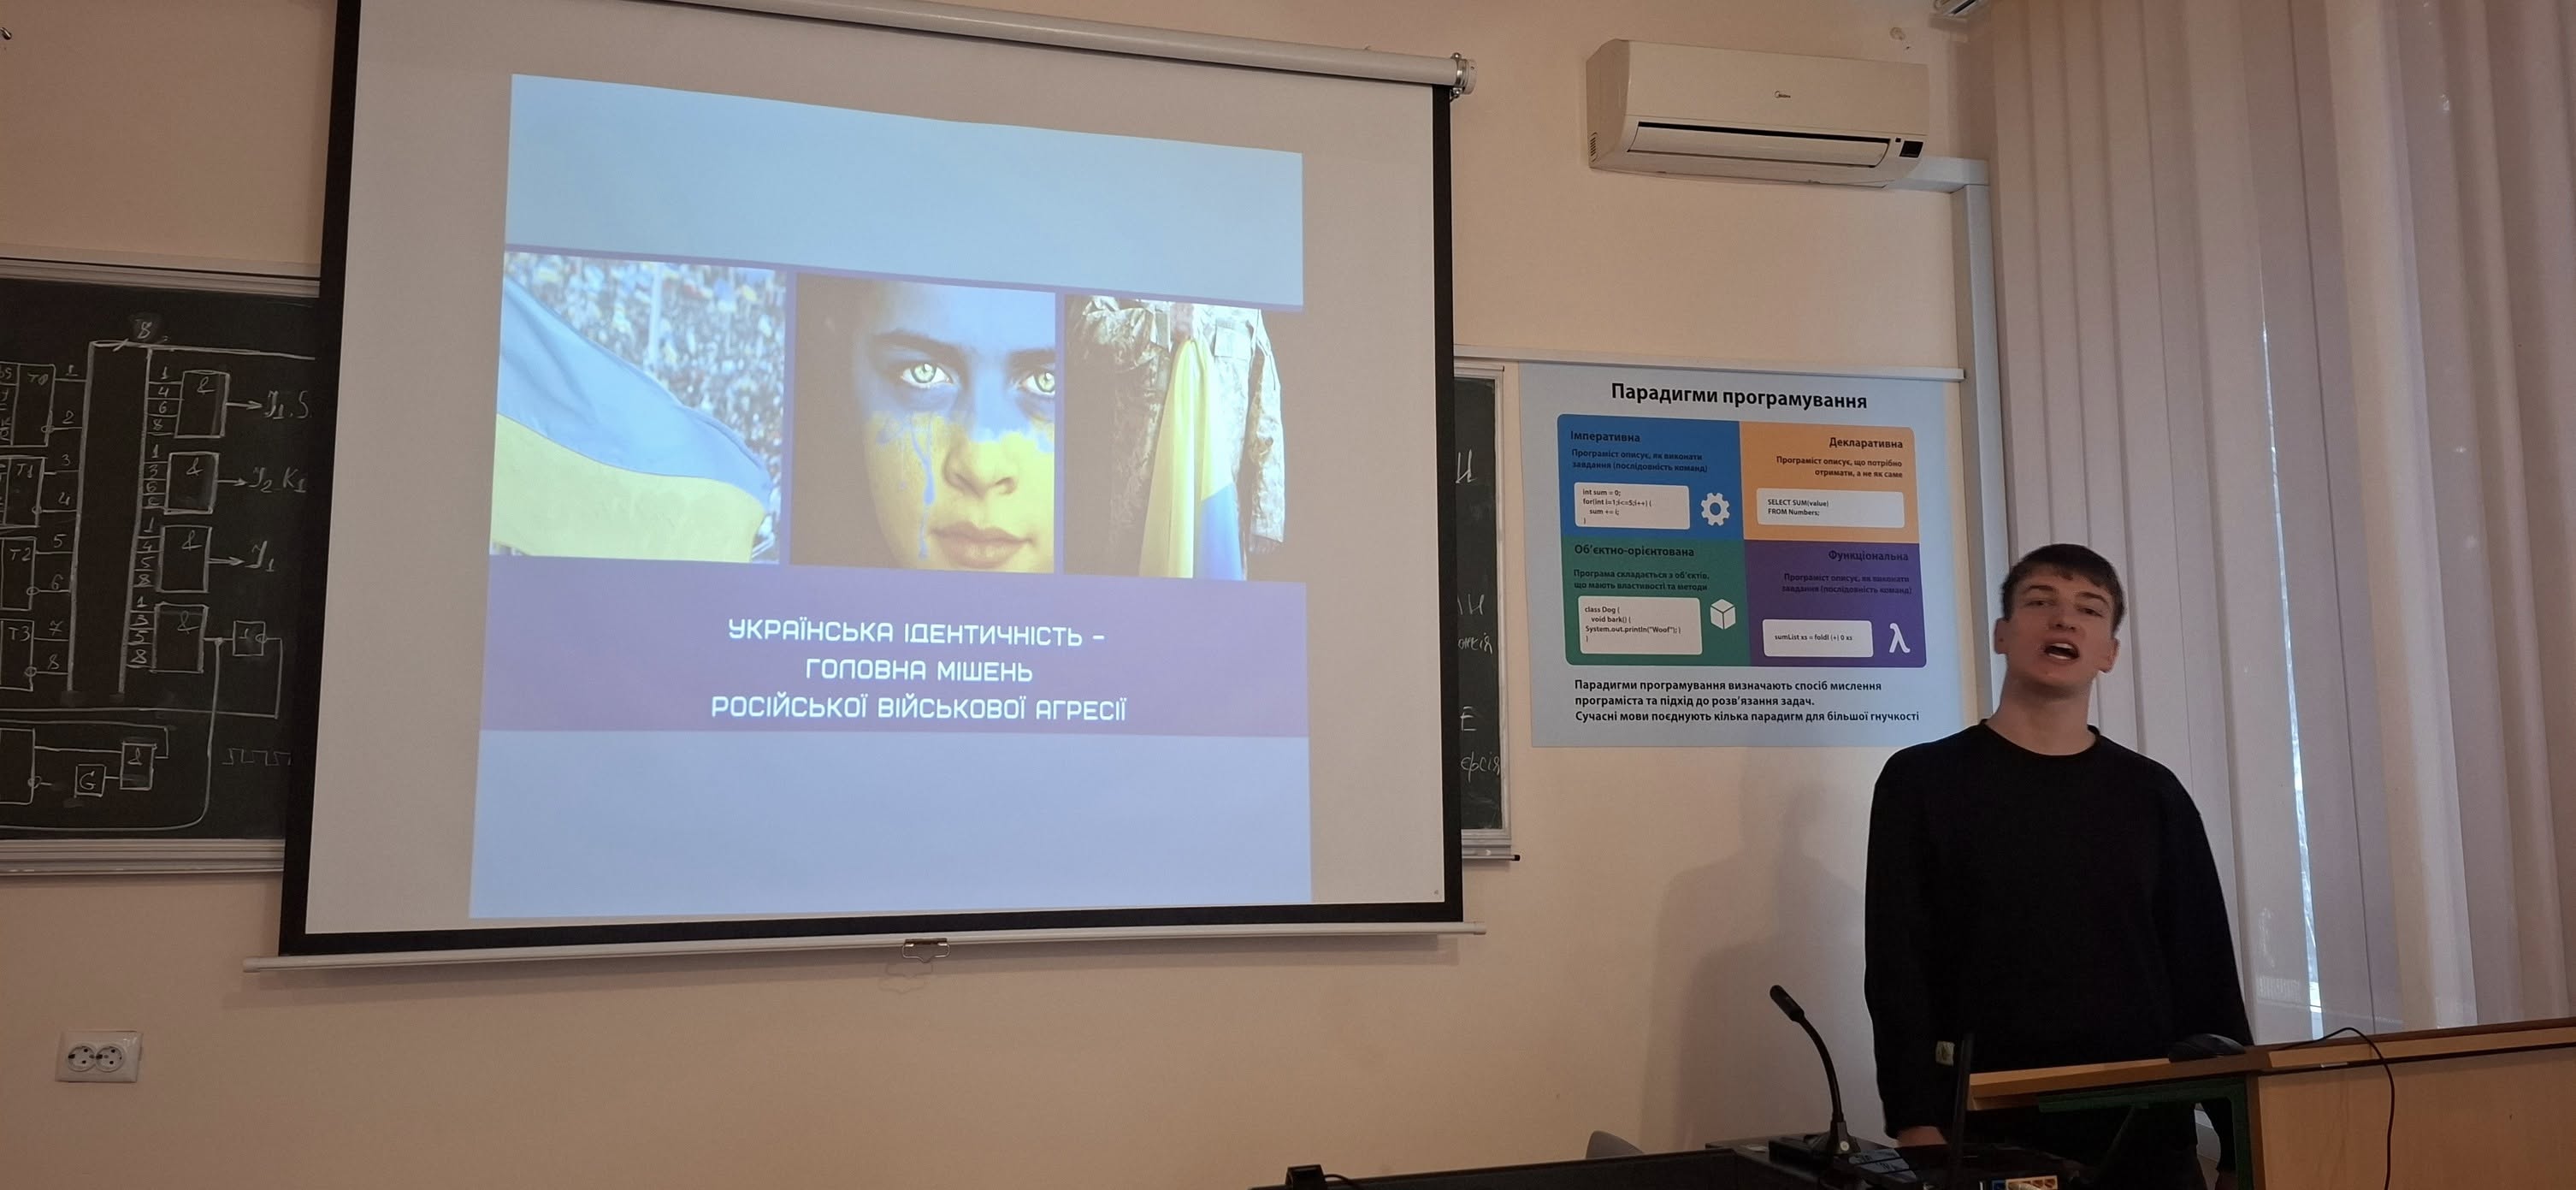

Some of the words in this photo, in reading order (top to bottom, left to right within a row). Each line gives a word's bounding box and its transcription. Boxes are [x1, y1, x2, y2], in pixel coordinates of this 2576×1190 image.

[1611, 382, 1718, 404] Парадигми
[1722, 389, 1868, 411] програмування
[159, 400, 168, 414] 6
[62, 410, 75, 424] 2
[1570, 430, 1641, 443] Імперативна
[1829, 437, 1903, 449] Декларативна
[1572, 448, 1618, 459] Програміст
[62, 454, 71, 466] 3
[1776, 455, 1822, 465] Програміст
[1823, 459, 1852, 467] описує,
[1867, 459, 1903, 468] потрібно
[1815, 469, 1855, 477] отримати,
[1793, 499, 1829, 507] SUM(value)
[1788, 508, 1820, 517] Numbers;
[53, 534, 67, 548] 5
[1829, 550, 1909, 562] Функціональна
[1573, 569, 1616, 578] Програма
[1616, 571, 1668, 580] складається
[51, 574, 63, 590] 6
[1616, 582, 1666, 590] властивості
[728, 617, 893, 642] УКРАЇНСЬКА
[904, 623, 1084, 647] ІДЕНТИЧНІСТЬ
[806, 657, 927, 681] ГОЛОВНА
[937, 660, 1034, 683] МІШЕНЬ
[1575, 679, 1637, 691] Парадигми
[1640, 681, 1726, 692] програмування
[1728, 682, 1793, 690] визначають
[1794, 681, 1828, 690] спосіб
[1830, 683, 1882, 691] мислення
[711, 691, 867, 719] РОСІЙСЬКОЇ
[877, 693, 1027, 720] ВІЙСЬКОВОЇ
[1036, 696, 1128, 722] АГРЕСІЇ
[1575, 695, 1644, 707] програміста
[1645, 697, 1657, 706] та
[1660, 695, 1694, 707] підхід
[1696, 697, 1710, 707] до
[1781, 697, 1815, 707] задач.
[1575, 711, 1617, 723] Сучасні
[1620, 713, 1649, 721] мови
[1651, 713, 1711, 723] поєднують
[1714, 711, 1748, 721] кілька
[1751, 713, 1804, 723] парадигм
[1805, 713, 1825, 723] для
[1827, 711, 1868, 721] більшої
[1870, 712, 1920, 723] гнучкості
